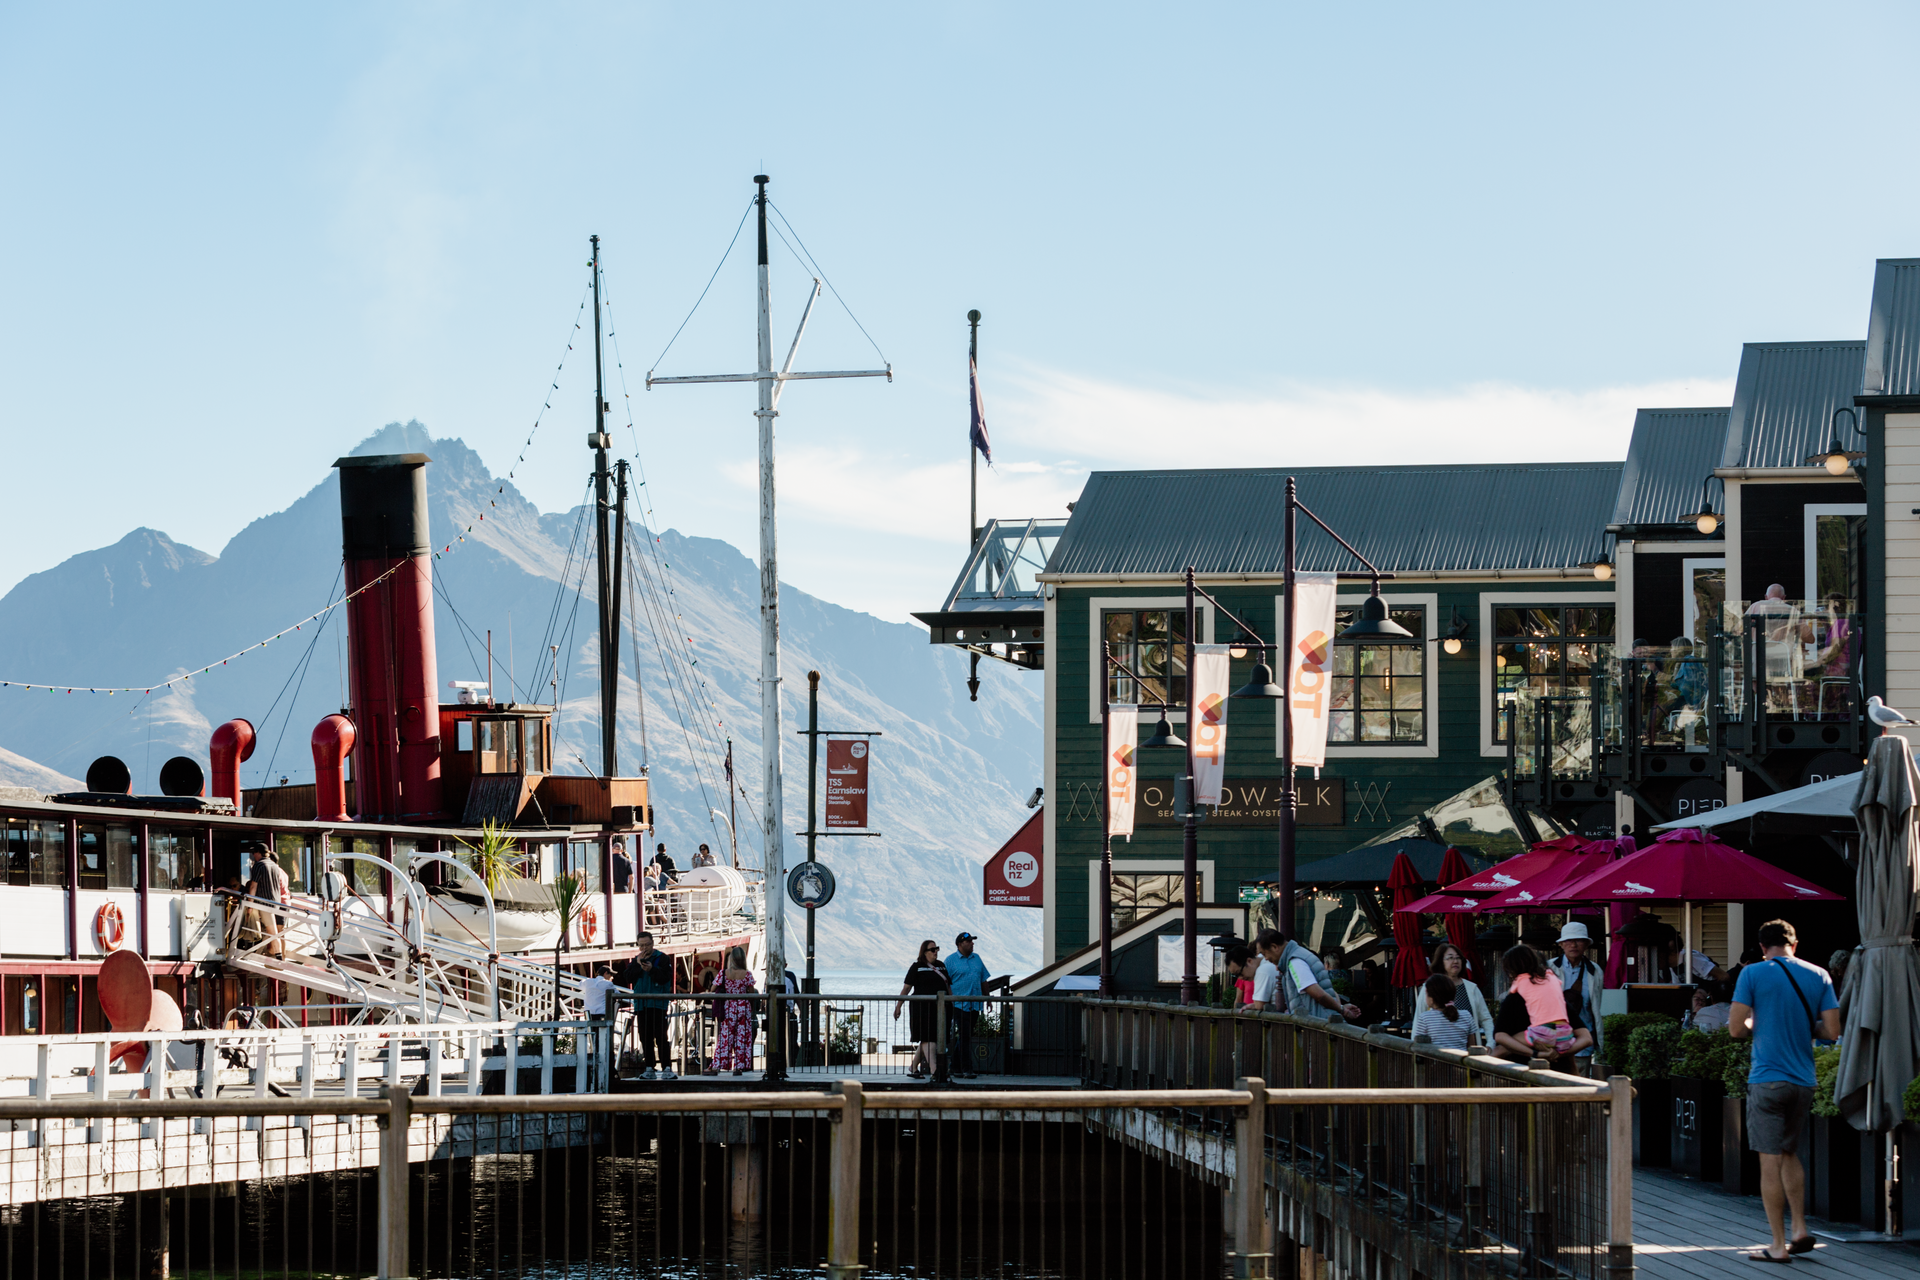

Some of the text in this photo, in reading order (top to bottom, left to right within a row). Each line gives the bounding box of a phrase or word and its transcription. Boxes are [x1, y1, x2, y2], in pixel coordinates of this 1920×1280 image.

[828, 778, 842, 787] TSS
[828, 786, 866, 795] Earnslaw
[1212, 809, 1281, 817] STEAK OYSTE
[1008, 860, 1033, 871] Real
[1008, 871, 1022, 879] nz
[1675, 1097, 1696, 1131] PIER
